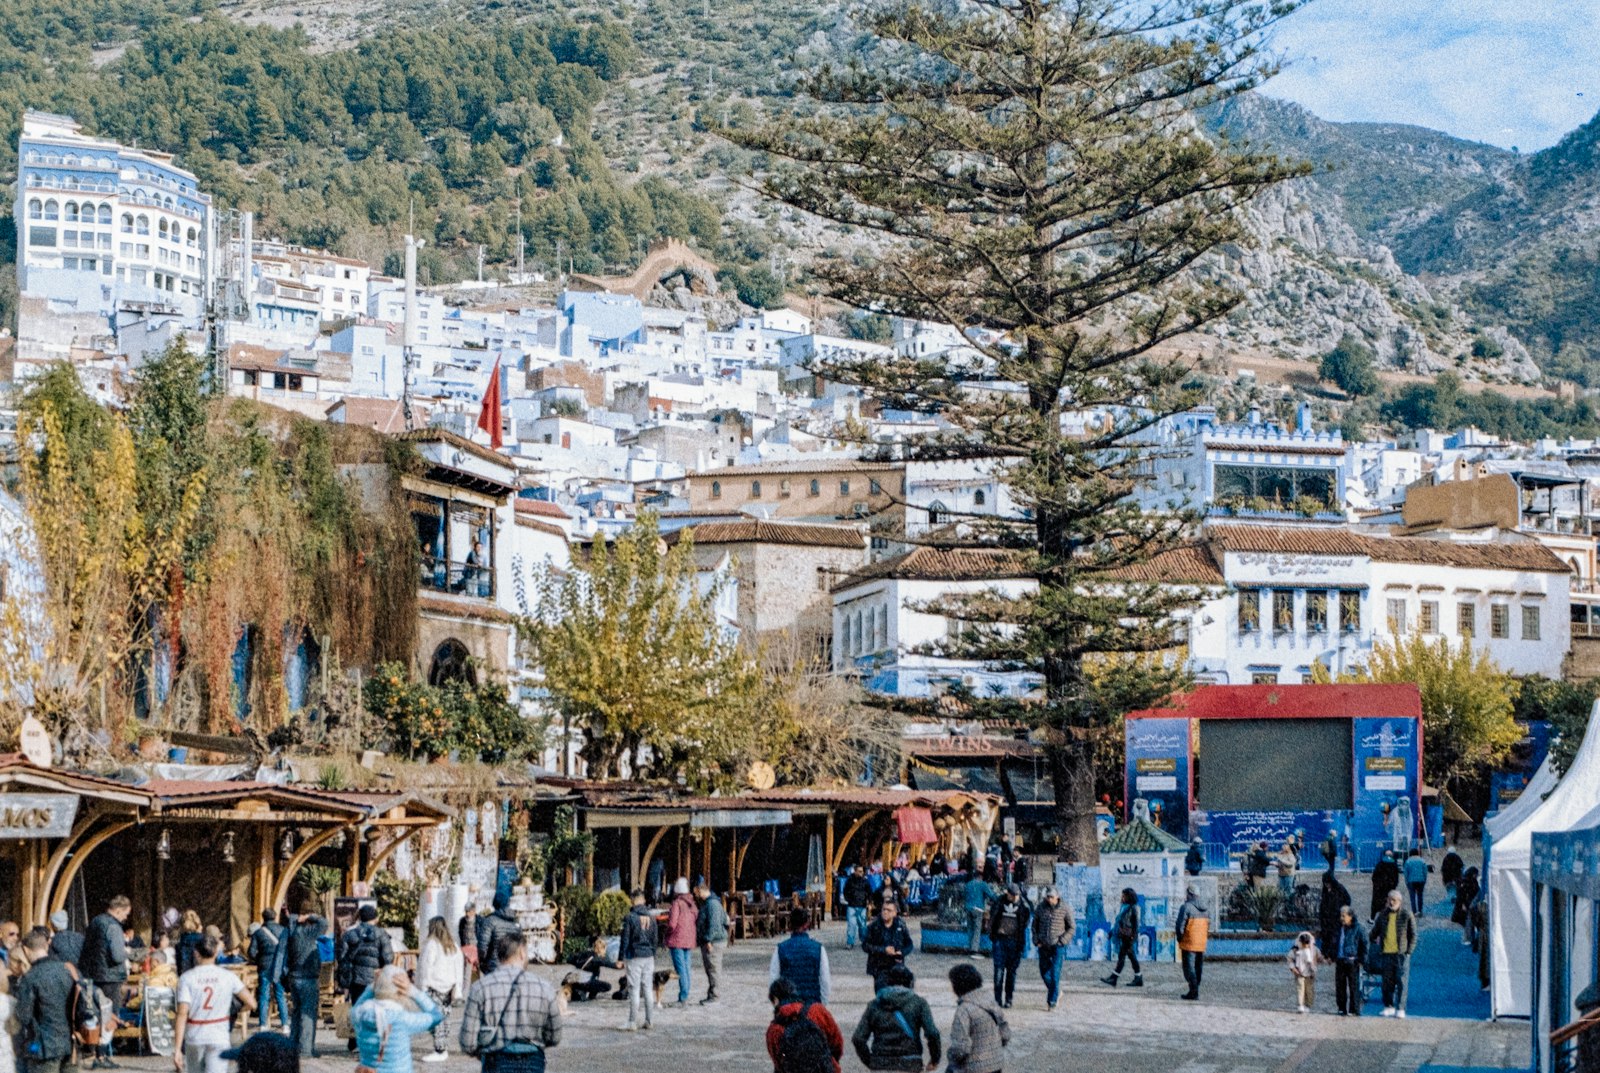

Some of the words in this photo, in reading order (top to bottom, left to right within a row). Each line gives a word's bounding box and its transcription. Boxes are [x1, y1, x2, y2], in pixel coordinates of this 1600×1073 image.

[924, 736, 992, 752] TWINS
[0, 807, 51, 828] MOS
[1262, 826, 1288, 837] المعرض
[203, 986, 213, 1010] 2
